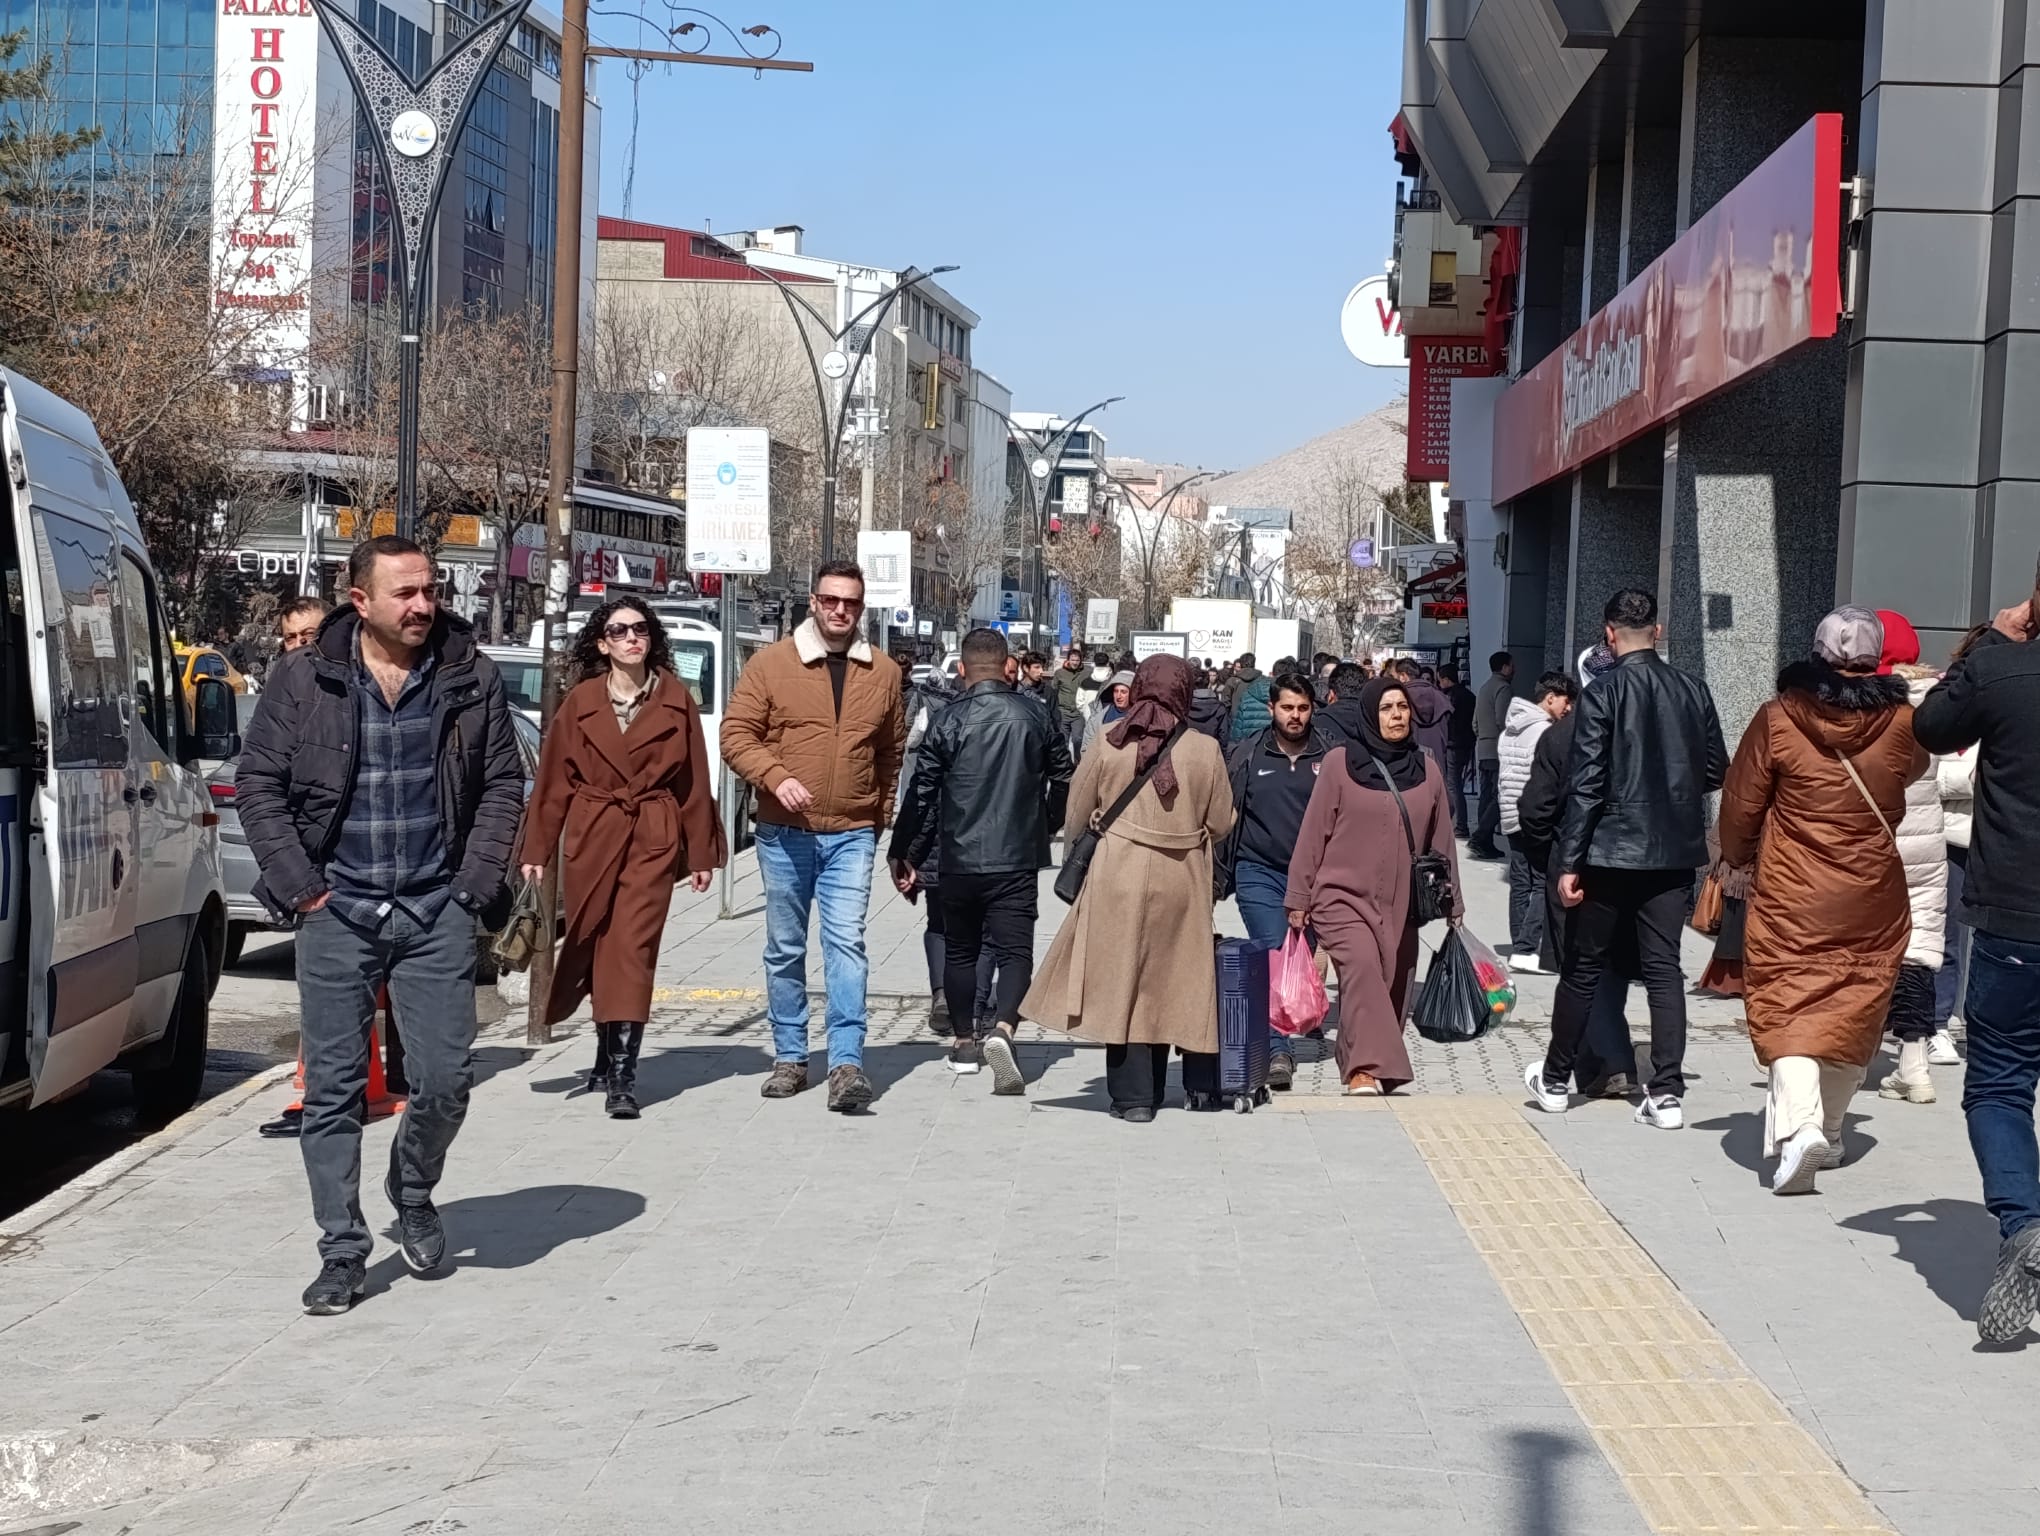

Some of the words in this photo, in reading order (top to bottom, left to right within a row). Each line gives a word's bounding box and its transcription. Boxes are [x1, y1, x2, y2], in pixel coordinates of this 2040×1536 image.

[249, 27, 286, 214] HOTEL
[244, 259, 276, 283] Spa
[1429, 366, 1463, 375] DÖNER
[1212, 629, 1233, 637] KAN
